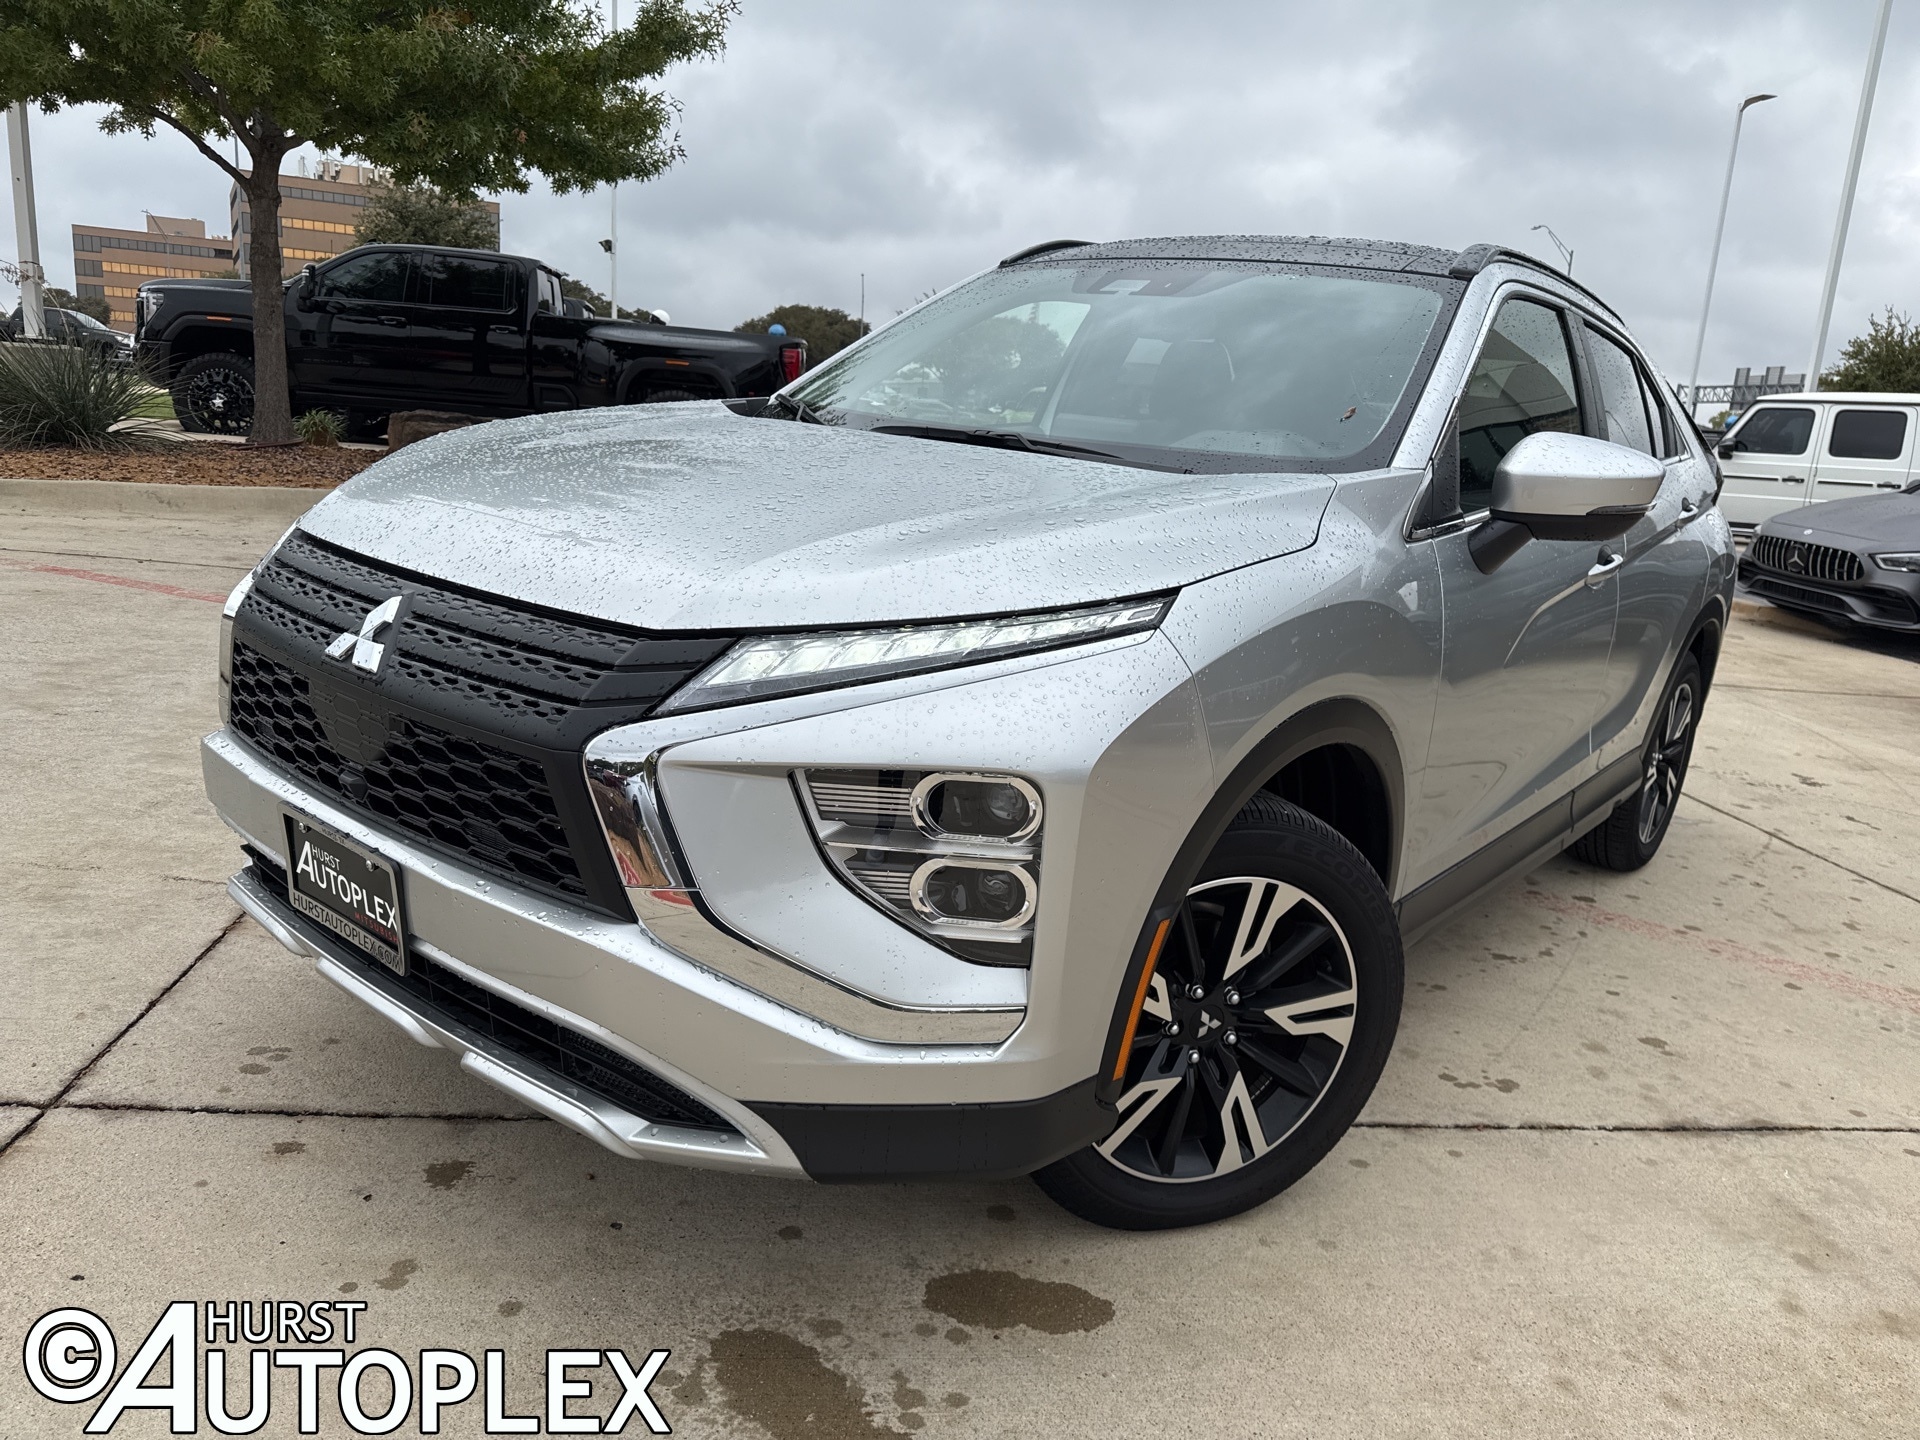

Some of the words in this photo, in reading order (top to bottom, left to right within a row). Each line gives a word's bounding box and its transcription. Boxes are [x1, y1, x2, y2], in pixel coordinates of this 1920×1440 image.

[296, 840, 398, 931] AUTOPLEX
[311, 844, 341, 871] HURST
[293, 892, 400, 971] HURSTAUTOPLEX.COM
[354, 911, 398, 944] MITSUBISH
